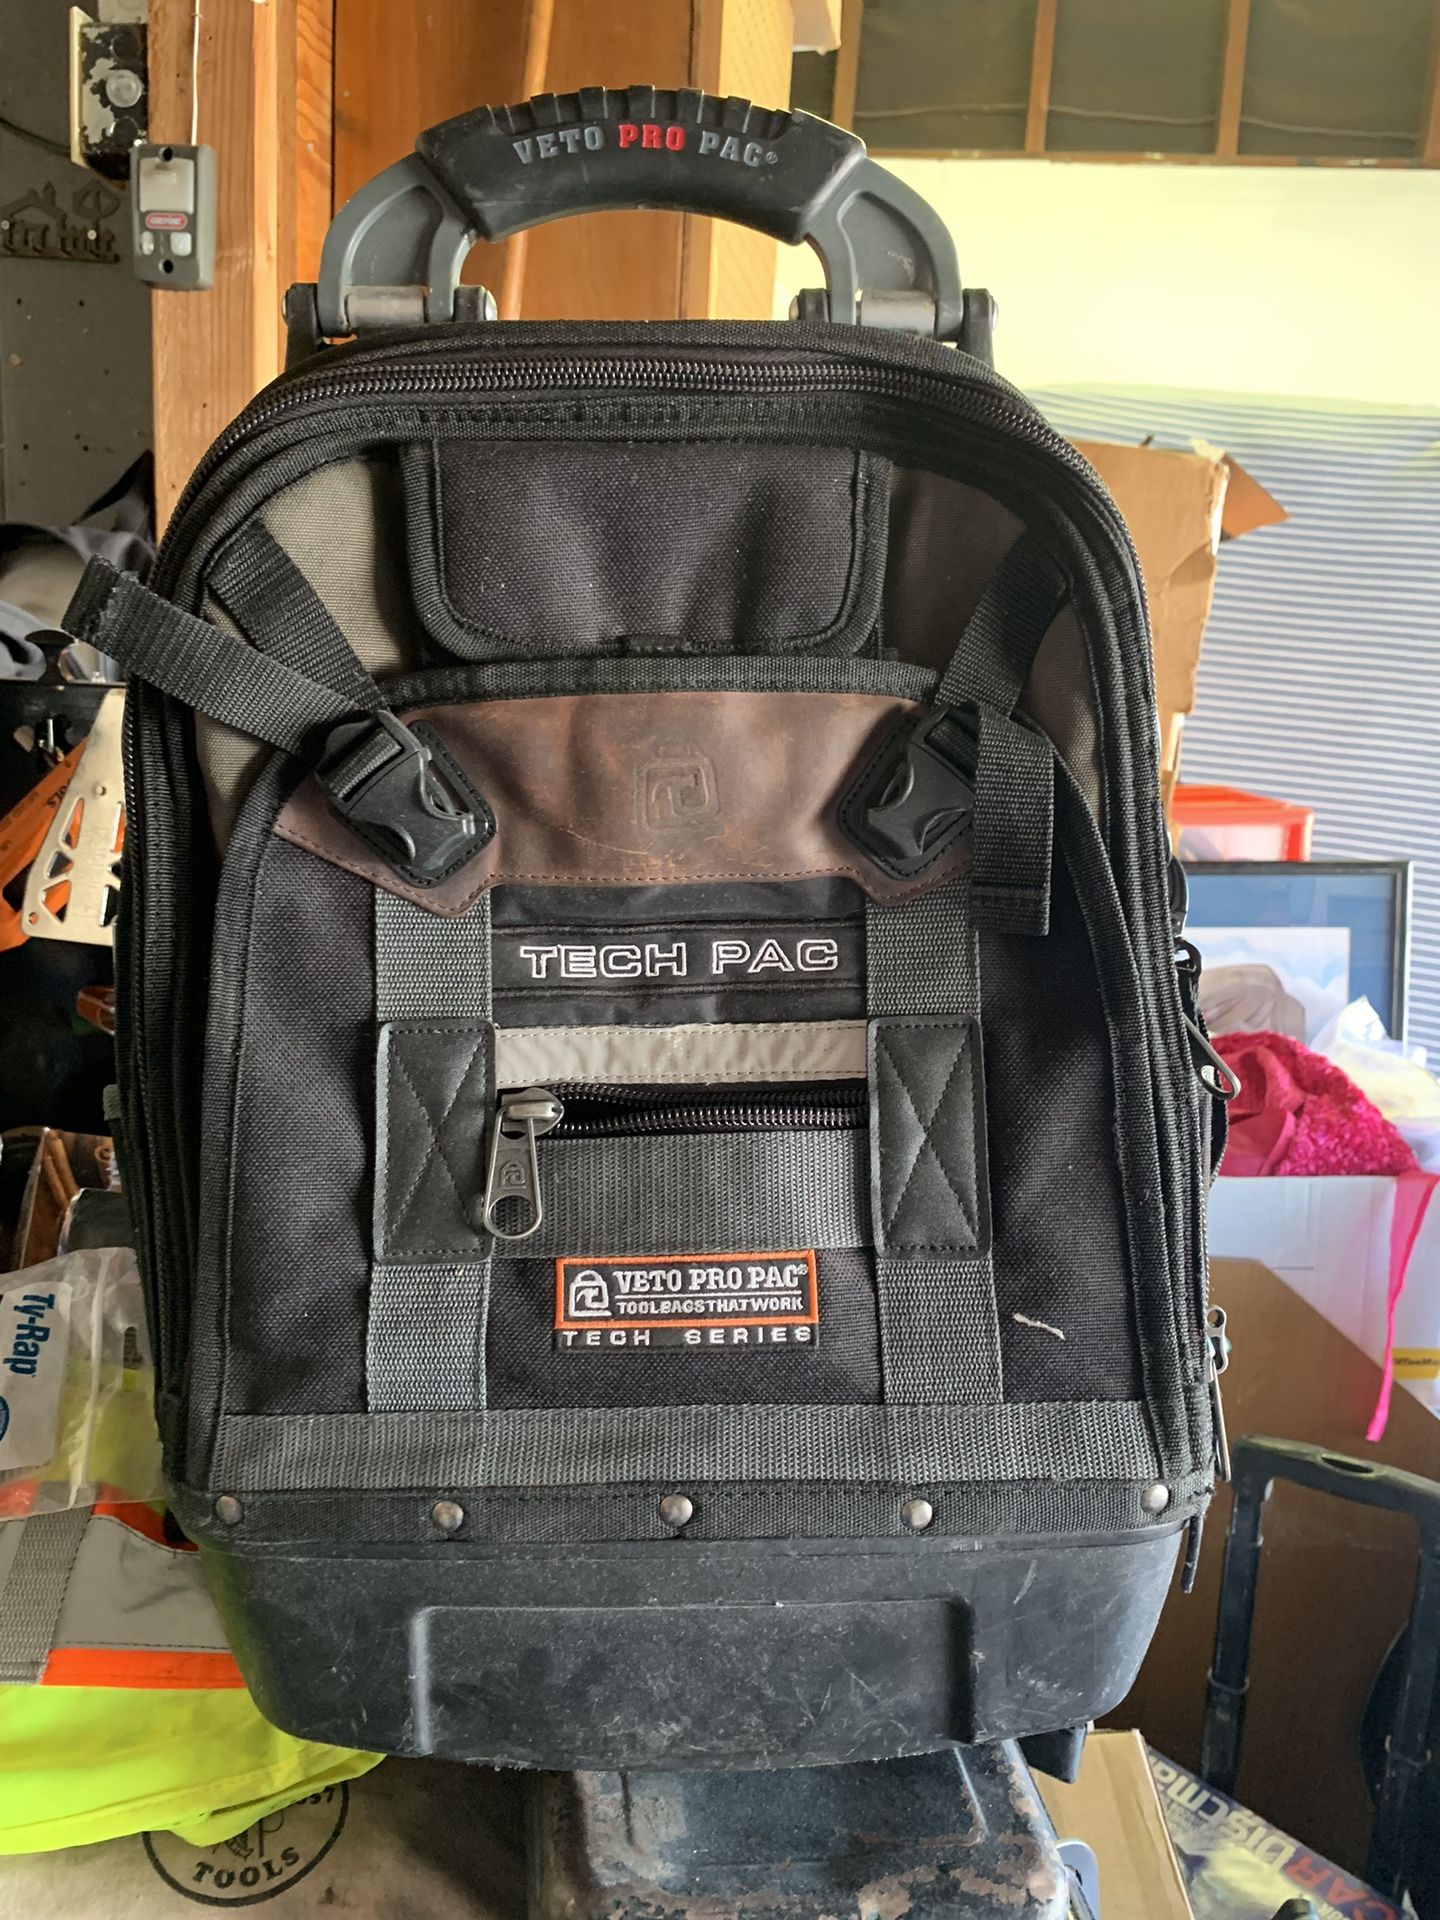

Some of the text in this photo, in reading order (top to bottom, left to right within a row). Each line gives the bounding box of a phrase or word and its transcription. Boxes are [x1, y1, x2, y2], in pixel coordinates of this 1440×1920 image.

[513, 126, 605, 164] VETO
[619, 124, 686, 151] PRO
[520, 939, 838, 978] TECH PAC
[613, 1269, 682, 1294] VETO
[689, 1267, 743, 1291] PRO
[3, 1293, 56, 1376] Ty-Rap
[562, 1326, 812, 1346] TECH SERIES
[193, 1846, 300, 1888] TOOLS
